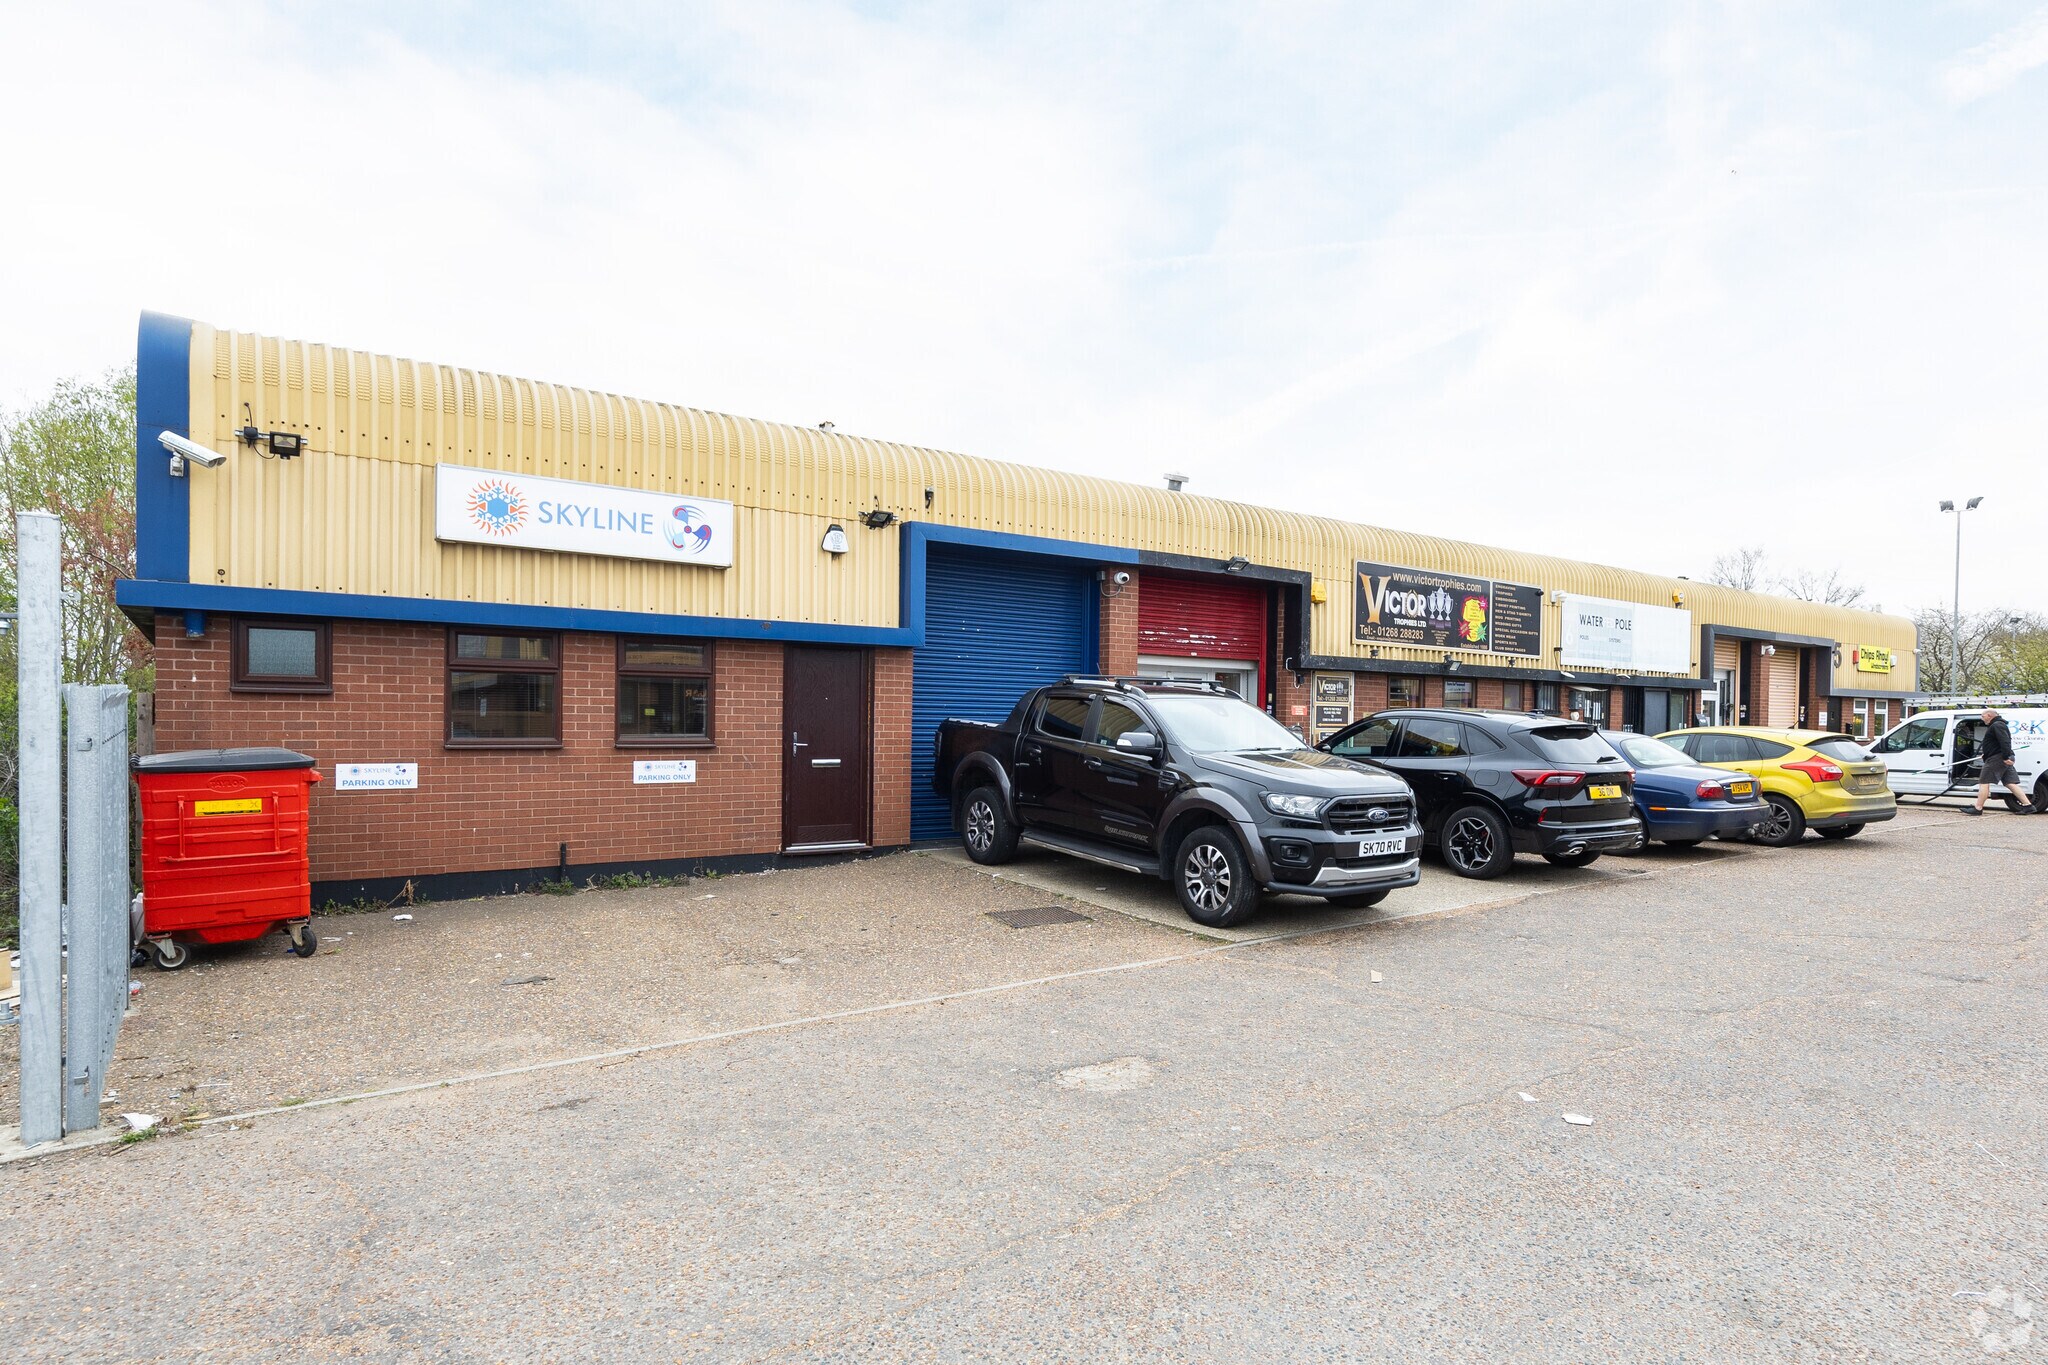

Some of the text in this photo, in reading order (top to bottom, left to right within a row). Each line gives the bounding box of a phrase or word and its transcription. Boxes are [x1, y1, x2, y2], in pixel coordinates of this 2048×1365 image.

[538, 501, 654, 535] SKYLINE
[1393, 572, 1482, 593] www.victortrophies.com
[1359, 572, 1427, 625] VICTOR
[1394, 618, 1427, 628] TROPHIES LTD
[1579, 614, 1603, 628] WATER
[1615, 618, 1632, 631] POLE
[1360, 625, 1376, 636] Tel:-
[1377, 626, 1399, 638] 01268
[1400, 628, 1424, 640] 288283
[1834, 642, 1842, 669] 5
[1861, 648, 1875, 662] Chips
[210, 780, 245, 788] TAYLOR
[1363, 839, 1402, 855] SK70 RVC
